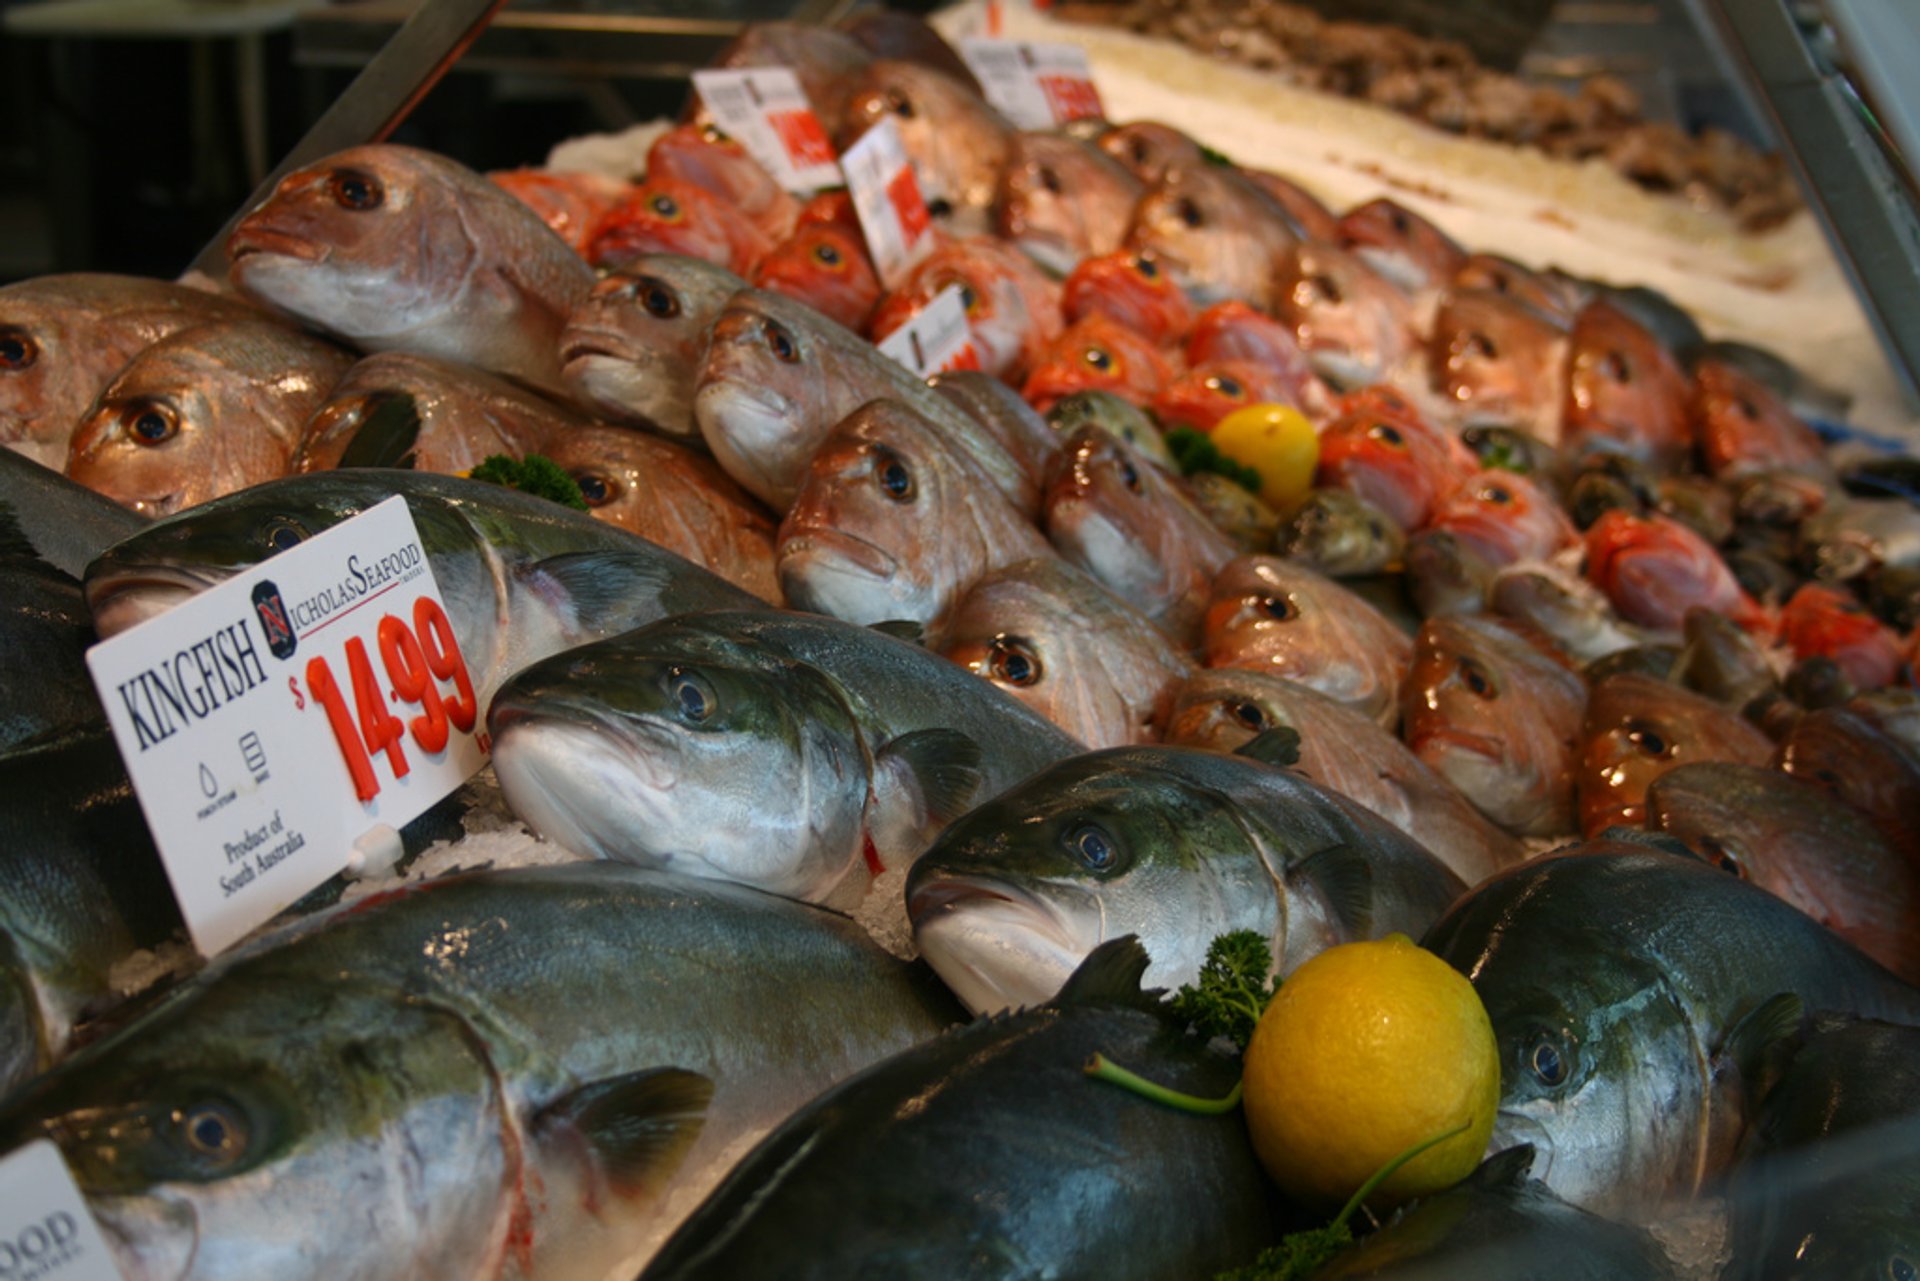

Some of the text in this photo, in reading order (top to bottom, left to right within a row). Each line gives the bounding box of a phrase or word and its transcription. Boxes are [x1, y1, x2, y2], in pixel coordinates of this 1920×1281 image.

[117, 619, 269, 752] KINGFISH
[219, 830, 306, 898] South Australia
[223, 808, 285, 865] Product of
